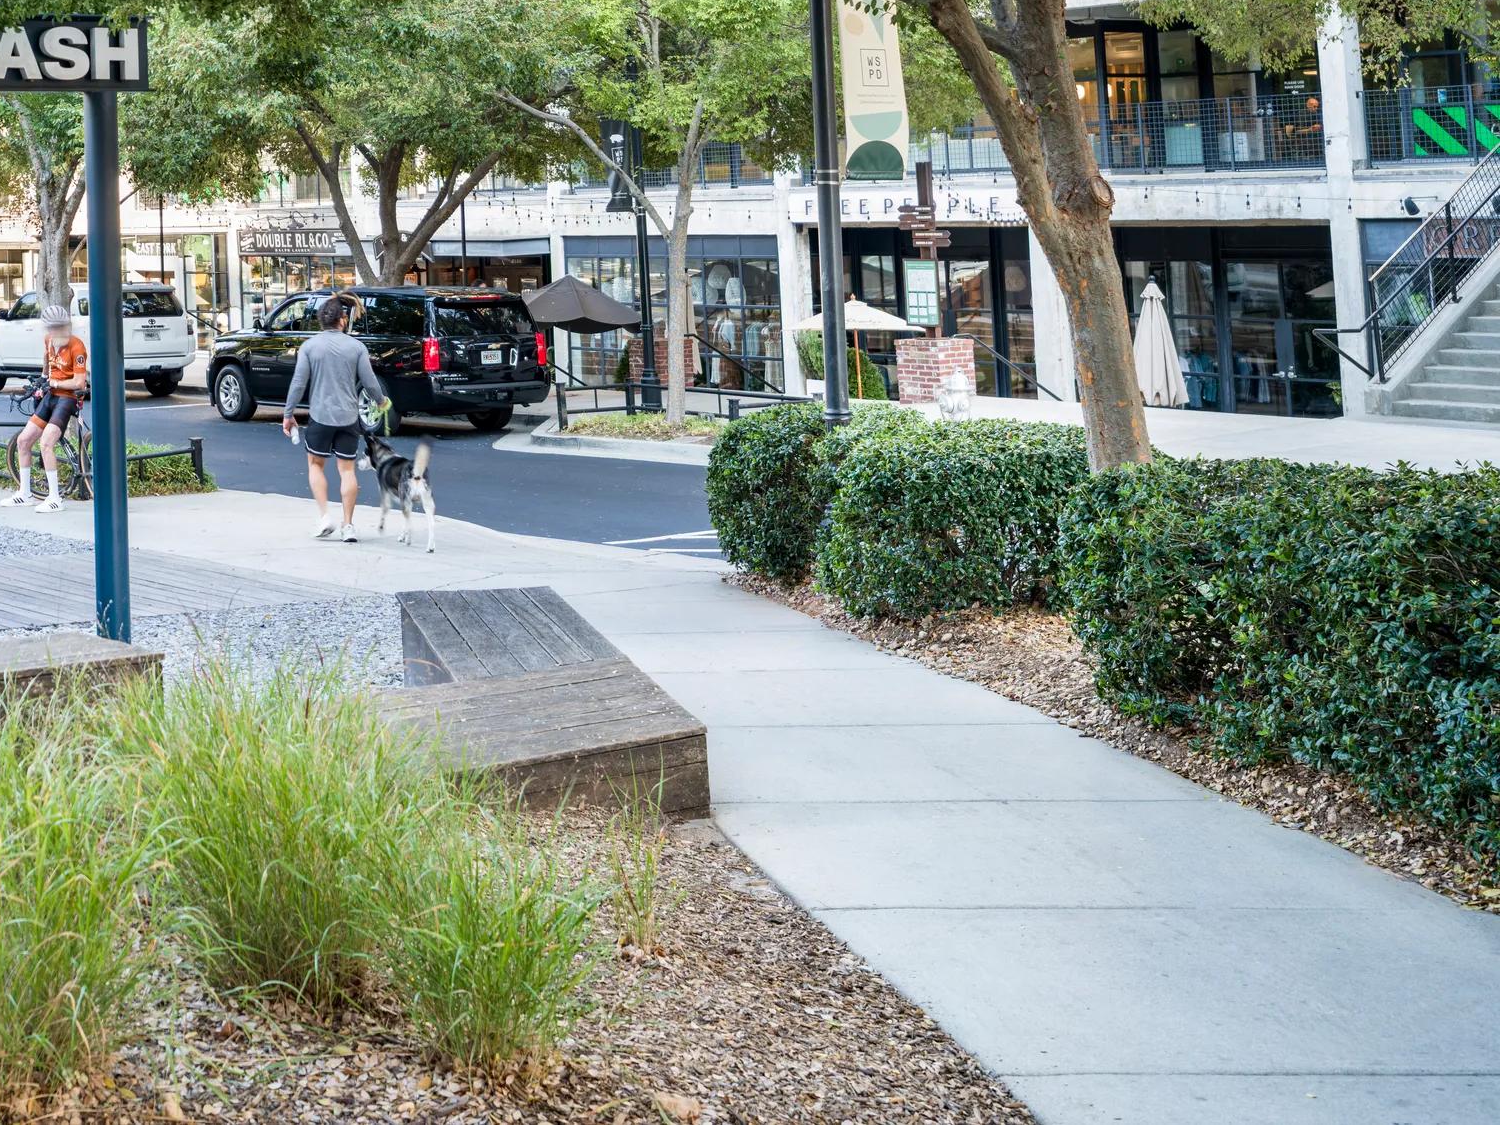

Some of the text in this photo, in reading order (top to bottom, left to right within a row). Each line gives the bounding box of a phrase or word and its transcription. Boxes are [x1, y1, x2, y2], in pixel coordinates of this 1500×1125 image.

[866, 55, 881, 67] WS
[868, 68, 882, 80] PD
[805, 198, 870, 216] FEE
[256, 233, 292, 248] DOUBLE
